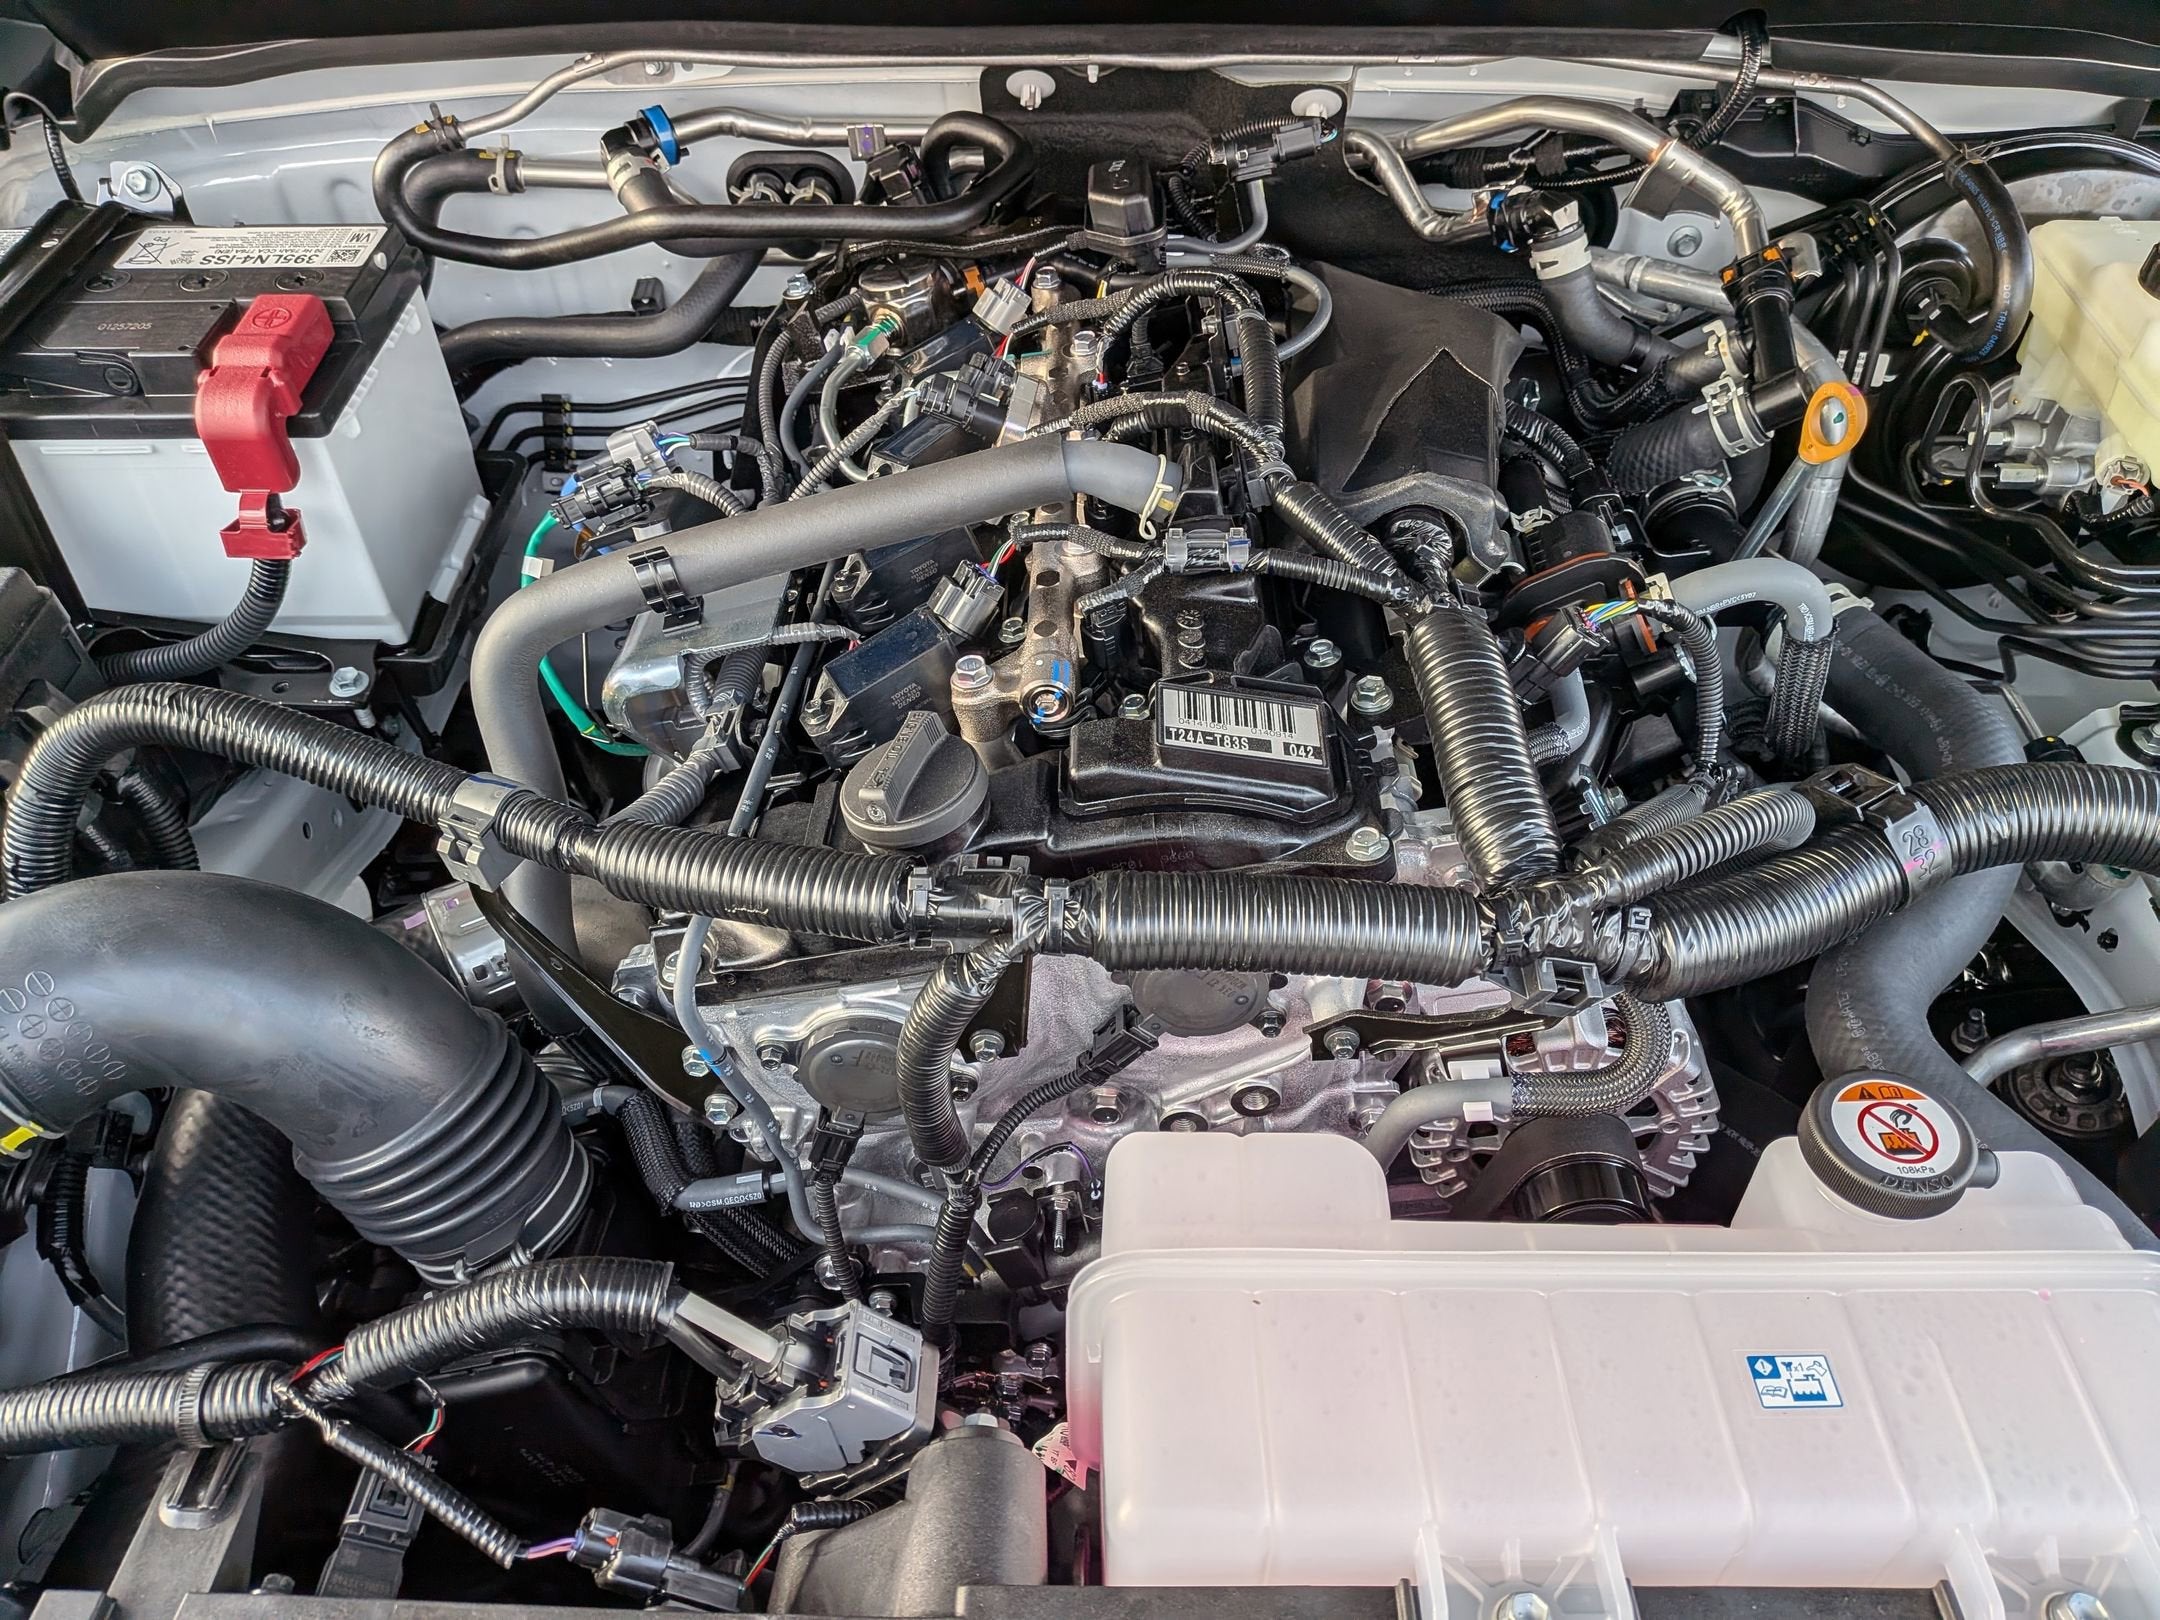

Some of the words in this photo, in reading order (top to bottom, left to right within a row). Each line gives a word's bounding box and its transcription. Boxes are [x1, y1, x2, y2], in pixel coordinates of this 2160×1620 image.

[350, 232, 371, 243] VM
[199, 253, 320, 265] 395LN4-ISS
[2003, 284, 2011, 305] DOT
[97, 322, 153, 331] 01257205
[909, 559, 935, 574] TOYOTA
[916, 568, 938, 583] DENSO
[890, 682, 918, 700] TOYOTA
[897, 692, 921, 709] DENSO
[1169, 727, 1249, 750] T24A-T83S
[1289, 744, 1315, 758] 042
[1902, 824, 1930, 857] 28
[1913, 848, 1943, 880] 32
[1896, 1165, 1937, 1176] 108kPa
[1879, 1175, 1955, 1194] DENSO
